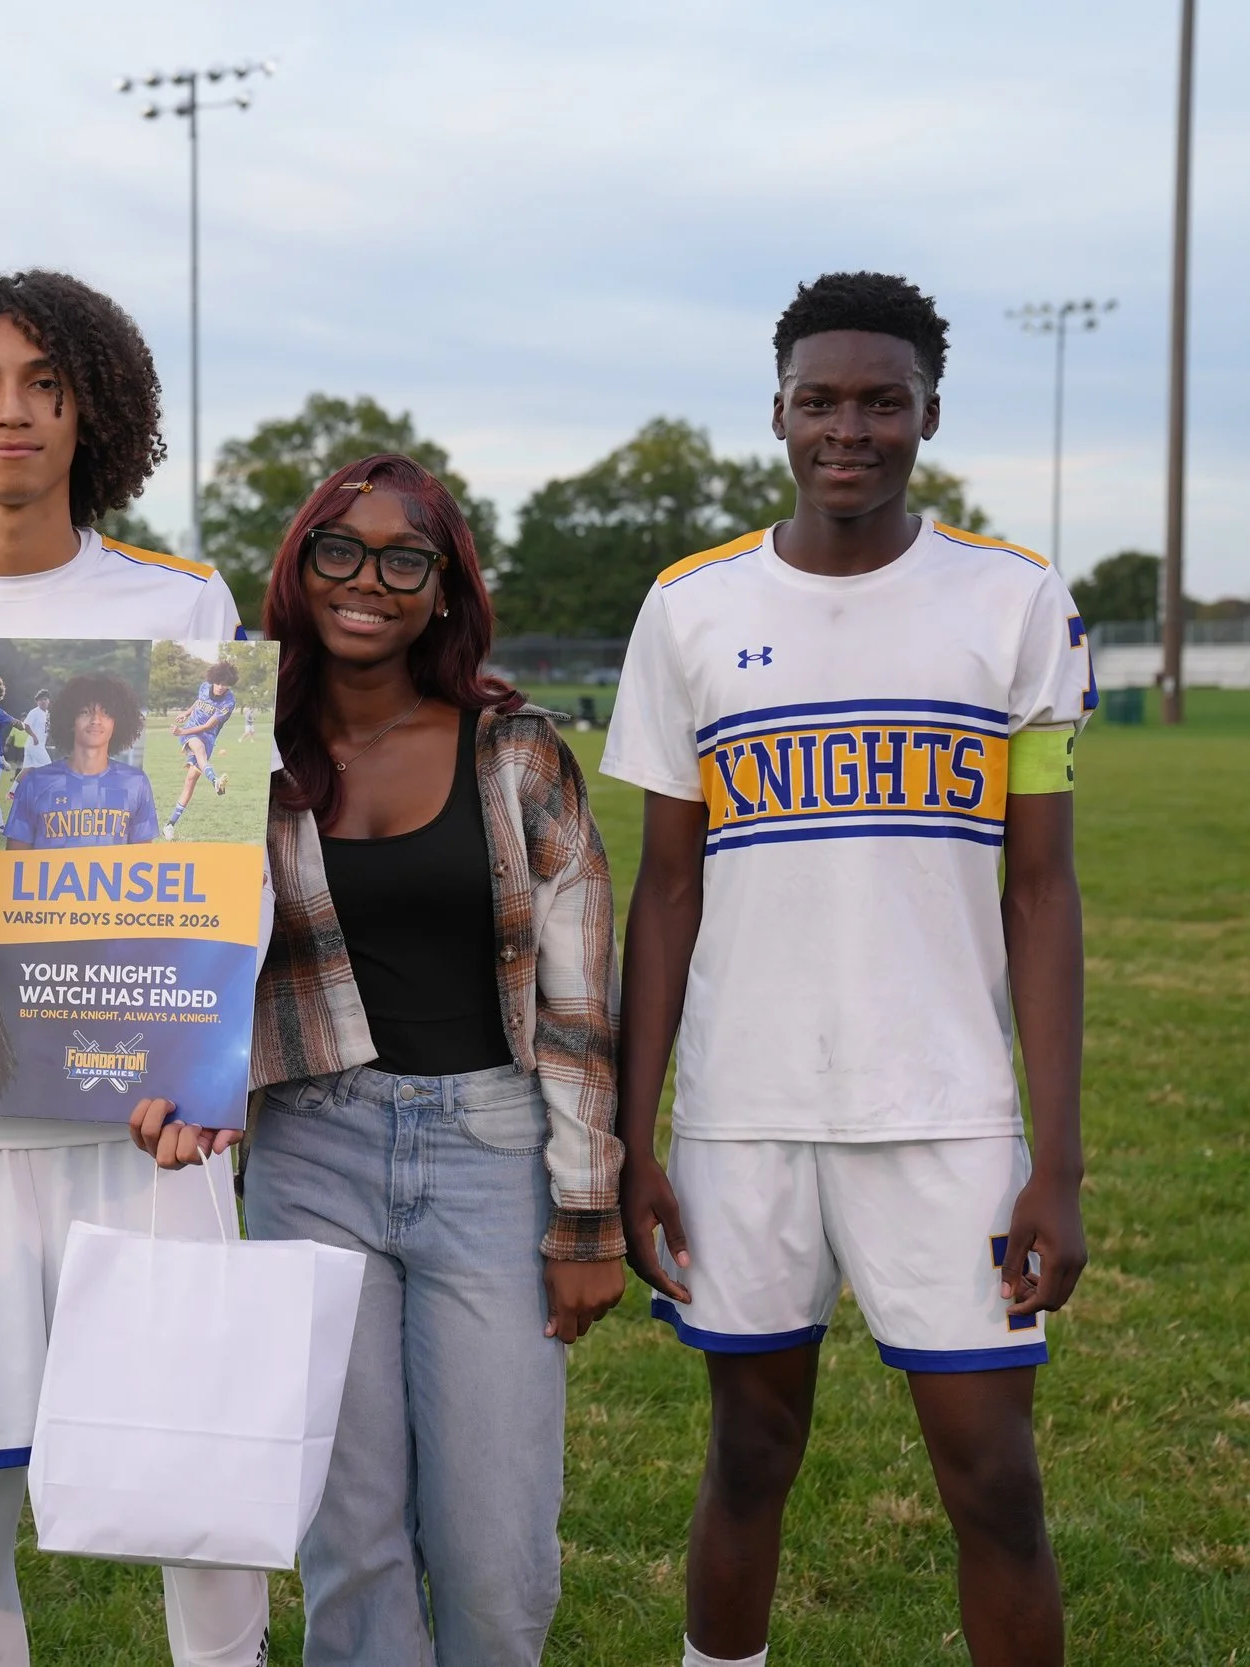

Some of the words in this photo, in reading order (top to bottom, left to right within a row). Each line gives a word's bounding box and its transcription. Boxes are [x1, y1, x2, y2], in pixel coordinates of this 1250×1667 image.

[715, 731, 985, 819] KNIGHTS
[43, 809, 130, 838] KNIGHTS
[12, 861, 206, 903] LIANSEL
[3, 911, 66, 925] VARSITY
[70, 912, 110, 926] BOYS
[114, 913, 175, 927] SOCCER
[180, 914, 220, 928] 2026
[21, 963, 79, 982] YOUR
[85, 965, 177, 984] KNIGHTS
[19, 986, 96, 1005] WATCH
[102, 988, 144, 1007] HAS
[150, 989, 217, 1008] ENDED
[19, 1009, 38, 1019] BUT
[41, 1009, 68, 1019] ONCE
[71, 1010, 79, 1019] A
[81, 1010, 121, 1021] KNIGHT,
[124, 1012, 167, 1022] ALWAYS
[170, 1013, 177, 1022] A
[180, 1013, 221, 1023] KNIGHT.
[67, 1049, 146, 1071] FOUNDATION
[76, 1068, 134, 1077] ACADEMIES
